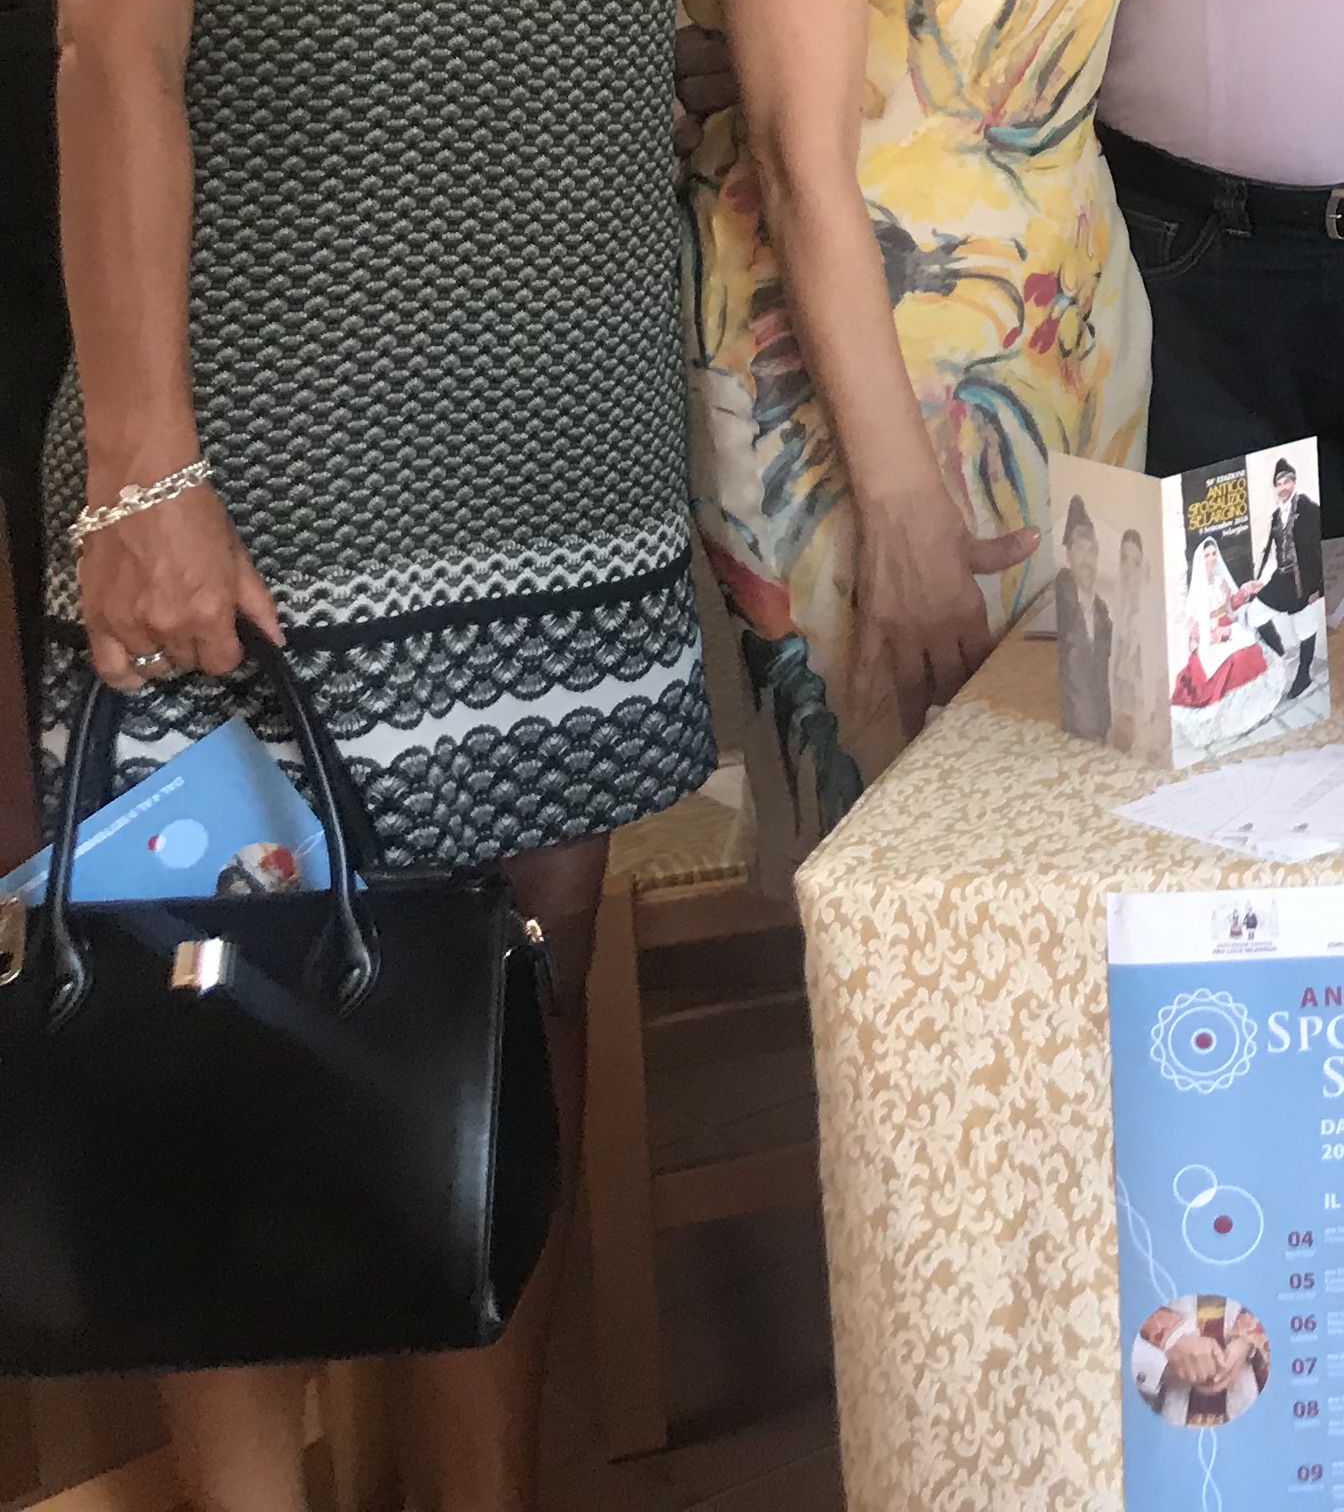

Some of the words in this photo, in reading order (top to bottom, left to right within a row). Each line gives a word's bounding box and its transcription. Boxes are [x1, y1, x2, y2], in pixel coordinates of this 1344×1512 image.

[1207, 477, 1246, 499] ANTICO
[1324, 1192, 1341, 1209] IL
[1288, 1230, 1314, 1248] 04
[1289, 1272, 1315, 1289] 05
[1290, 1314, 1317, 1333] 06
[1291, 1357, 1317, 1376] 07
[1292, 1400, 1319, 1418] 08
[1297, 1464, 1324, 1482] 09
